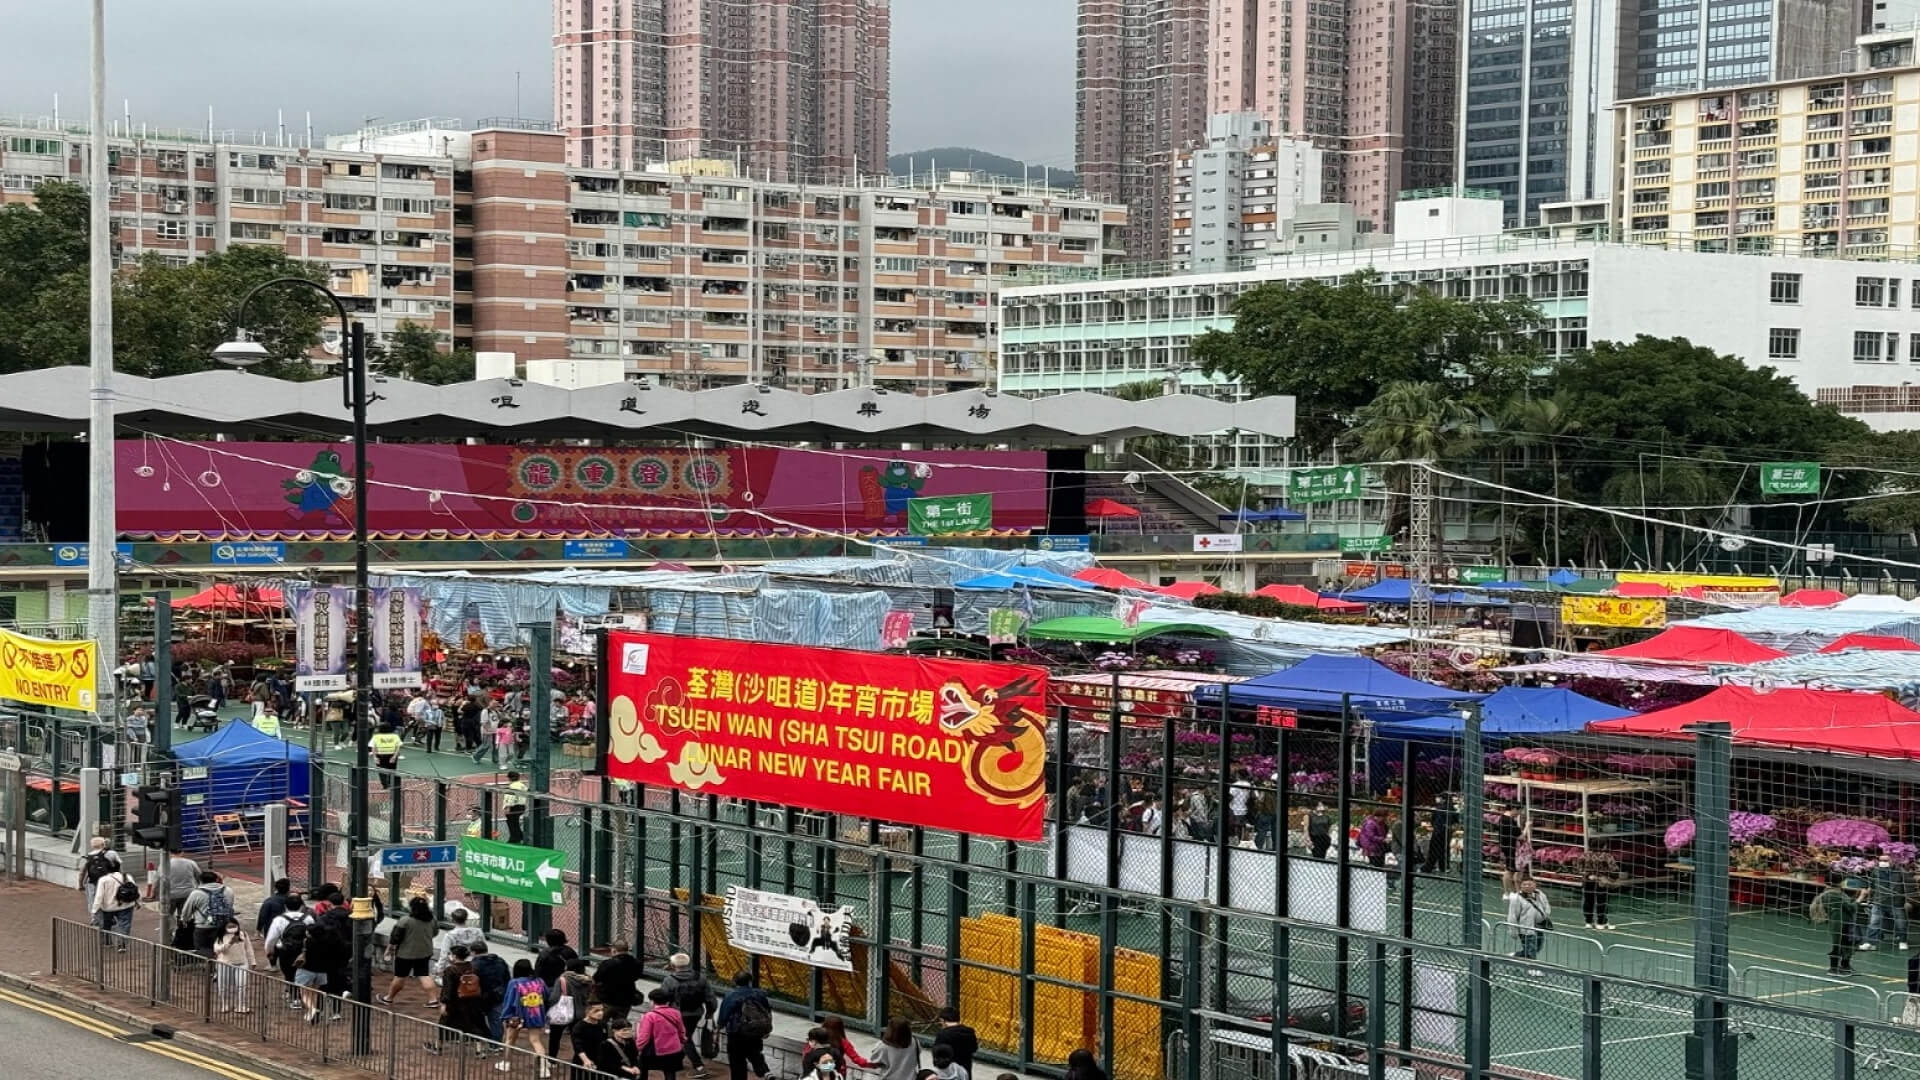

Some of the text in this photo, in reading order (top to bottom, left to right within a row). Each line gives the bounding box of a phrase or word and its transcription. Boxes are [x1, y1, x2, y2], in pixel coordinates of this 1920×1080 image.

[1296, 473, 1337, 489] 第二街
[925, 502, 972, 518] 第一街
[921, 521, 939, 529] THE
[955, 517, 981, 526] LANE
[15, 678, 71, 701] NO ENTRY
[686, 665, 936, 725] 荃灣(沙咀道)年宵市場
[656, 704, 971, 767] TSUEN WAN (SHA TSUI ROAD)
[687, 741, 932, 797] LUNAR NEW YEAR FAIR
[465, 867, 473, 876] To
[472, 869, 490, 880] Lunar
[491, 872, 505, 882] New
[722, 885, 738, 940] WUSHU
